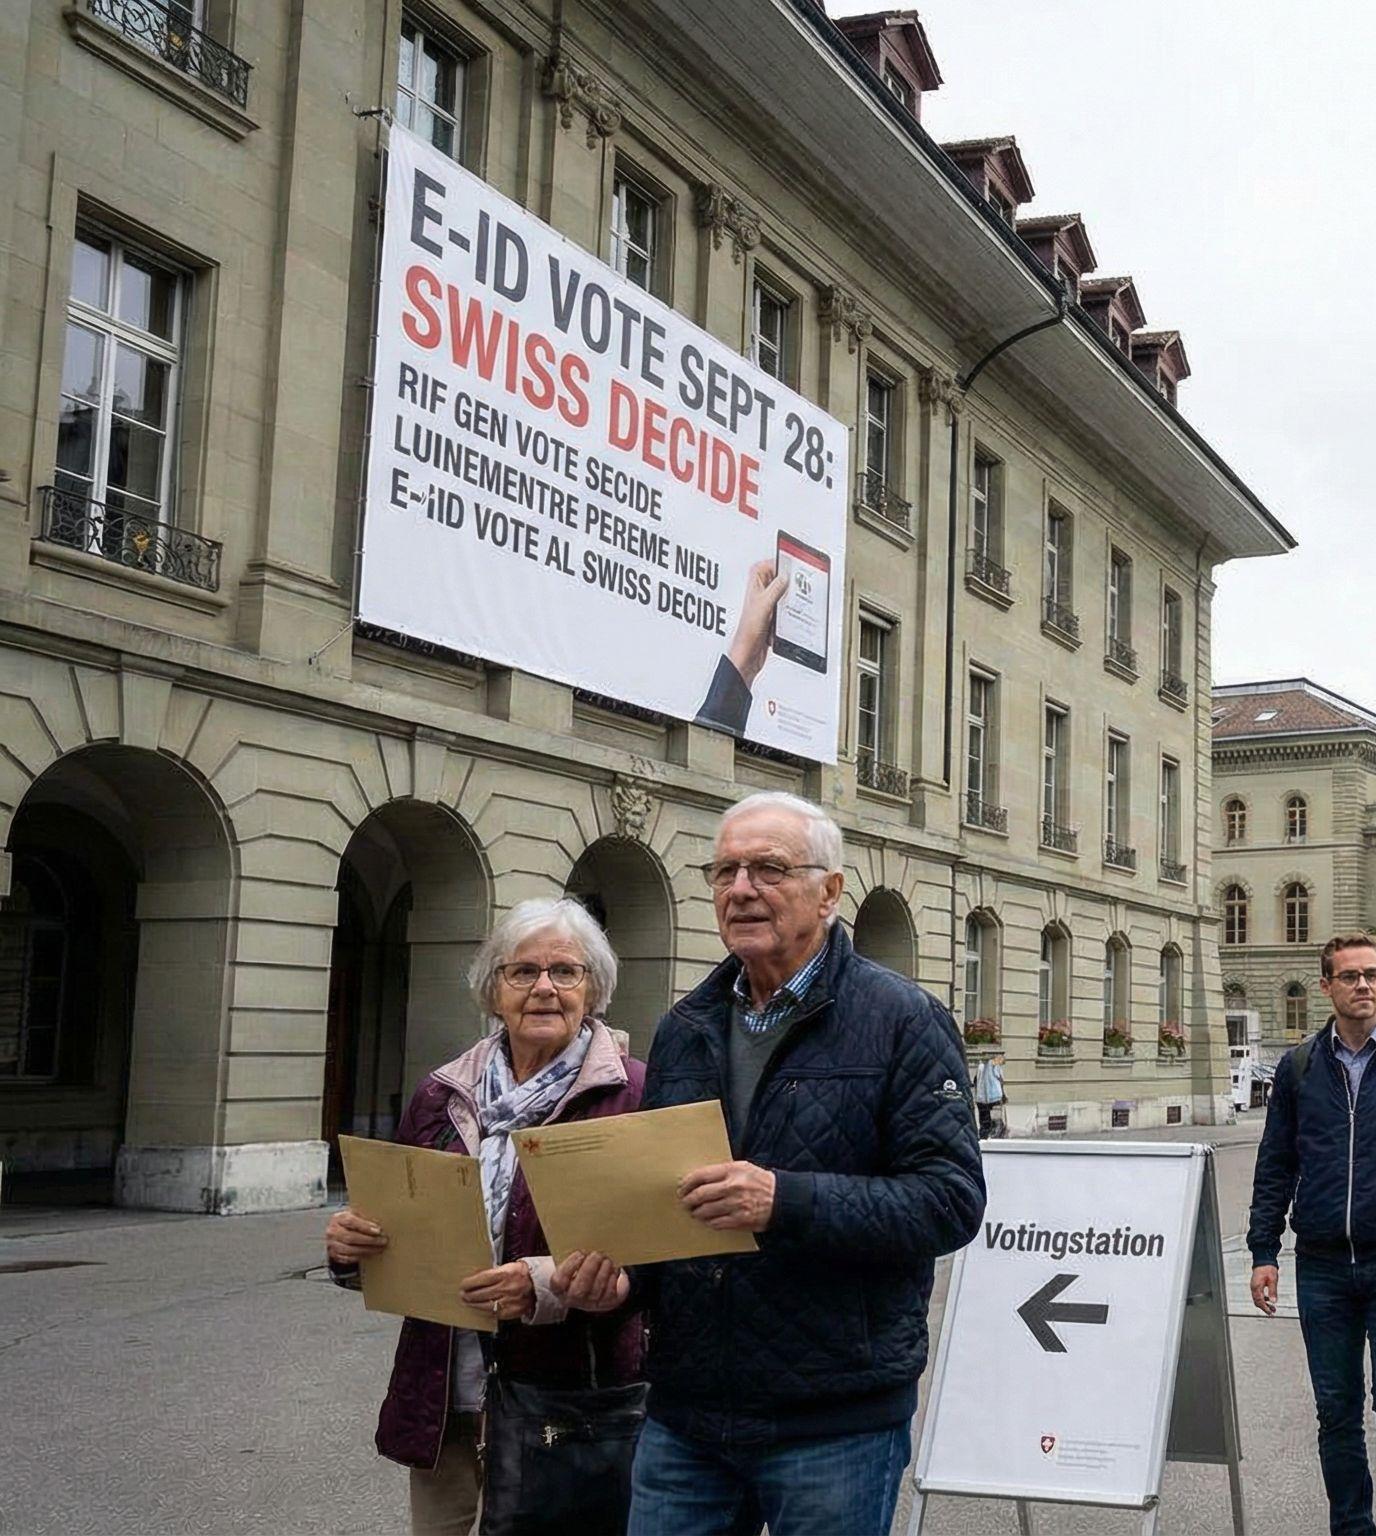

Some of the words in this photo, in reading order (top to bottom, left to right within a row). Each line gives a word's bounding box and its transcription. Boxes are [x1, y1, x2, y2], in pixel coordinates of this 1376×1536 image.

[402, 265, 590, 428] SWISS
[608, 379, 760, 520] DECIDE
[410, 168, 529, 303] E-ID
[548, 254, 666, 390] VOTE
[679, 345, 776, 452] SEPT
[784, 412, 834, 490] 28:
[394, 415, 580, 530] LUINEMENTRE
[585, 503, 670, 570] PEREME
[675, 545, 719, 591] NIEU
[398, 362, 447, 415] RIF
[454, 392, 508, 448] GEN
[515, 420, 579, 482] VOTE
[585, 456, 663, 522] SECIDE
[474, 502, 540, 562] VOTE
[545, 535, 576, 577] AL
[583, 550, 651, 606] SWISS
[657, 581, 727, 637] DECIDE
[985, 1222, 1165, 1261] Votingstation
